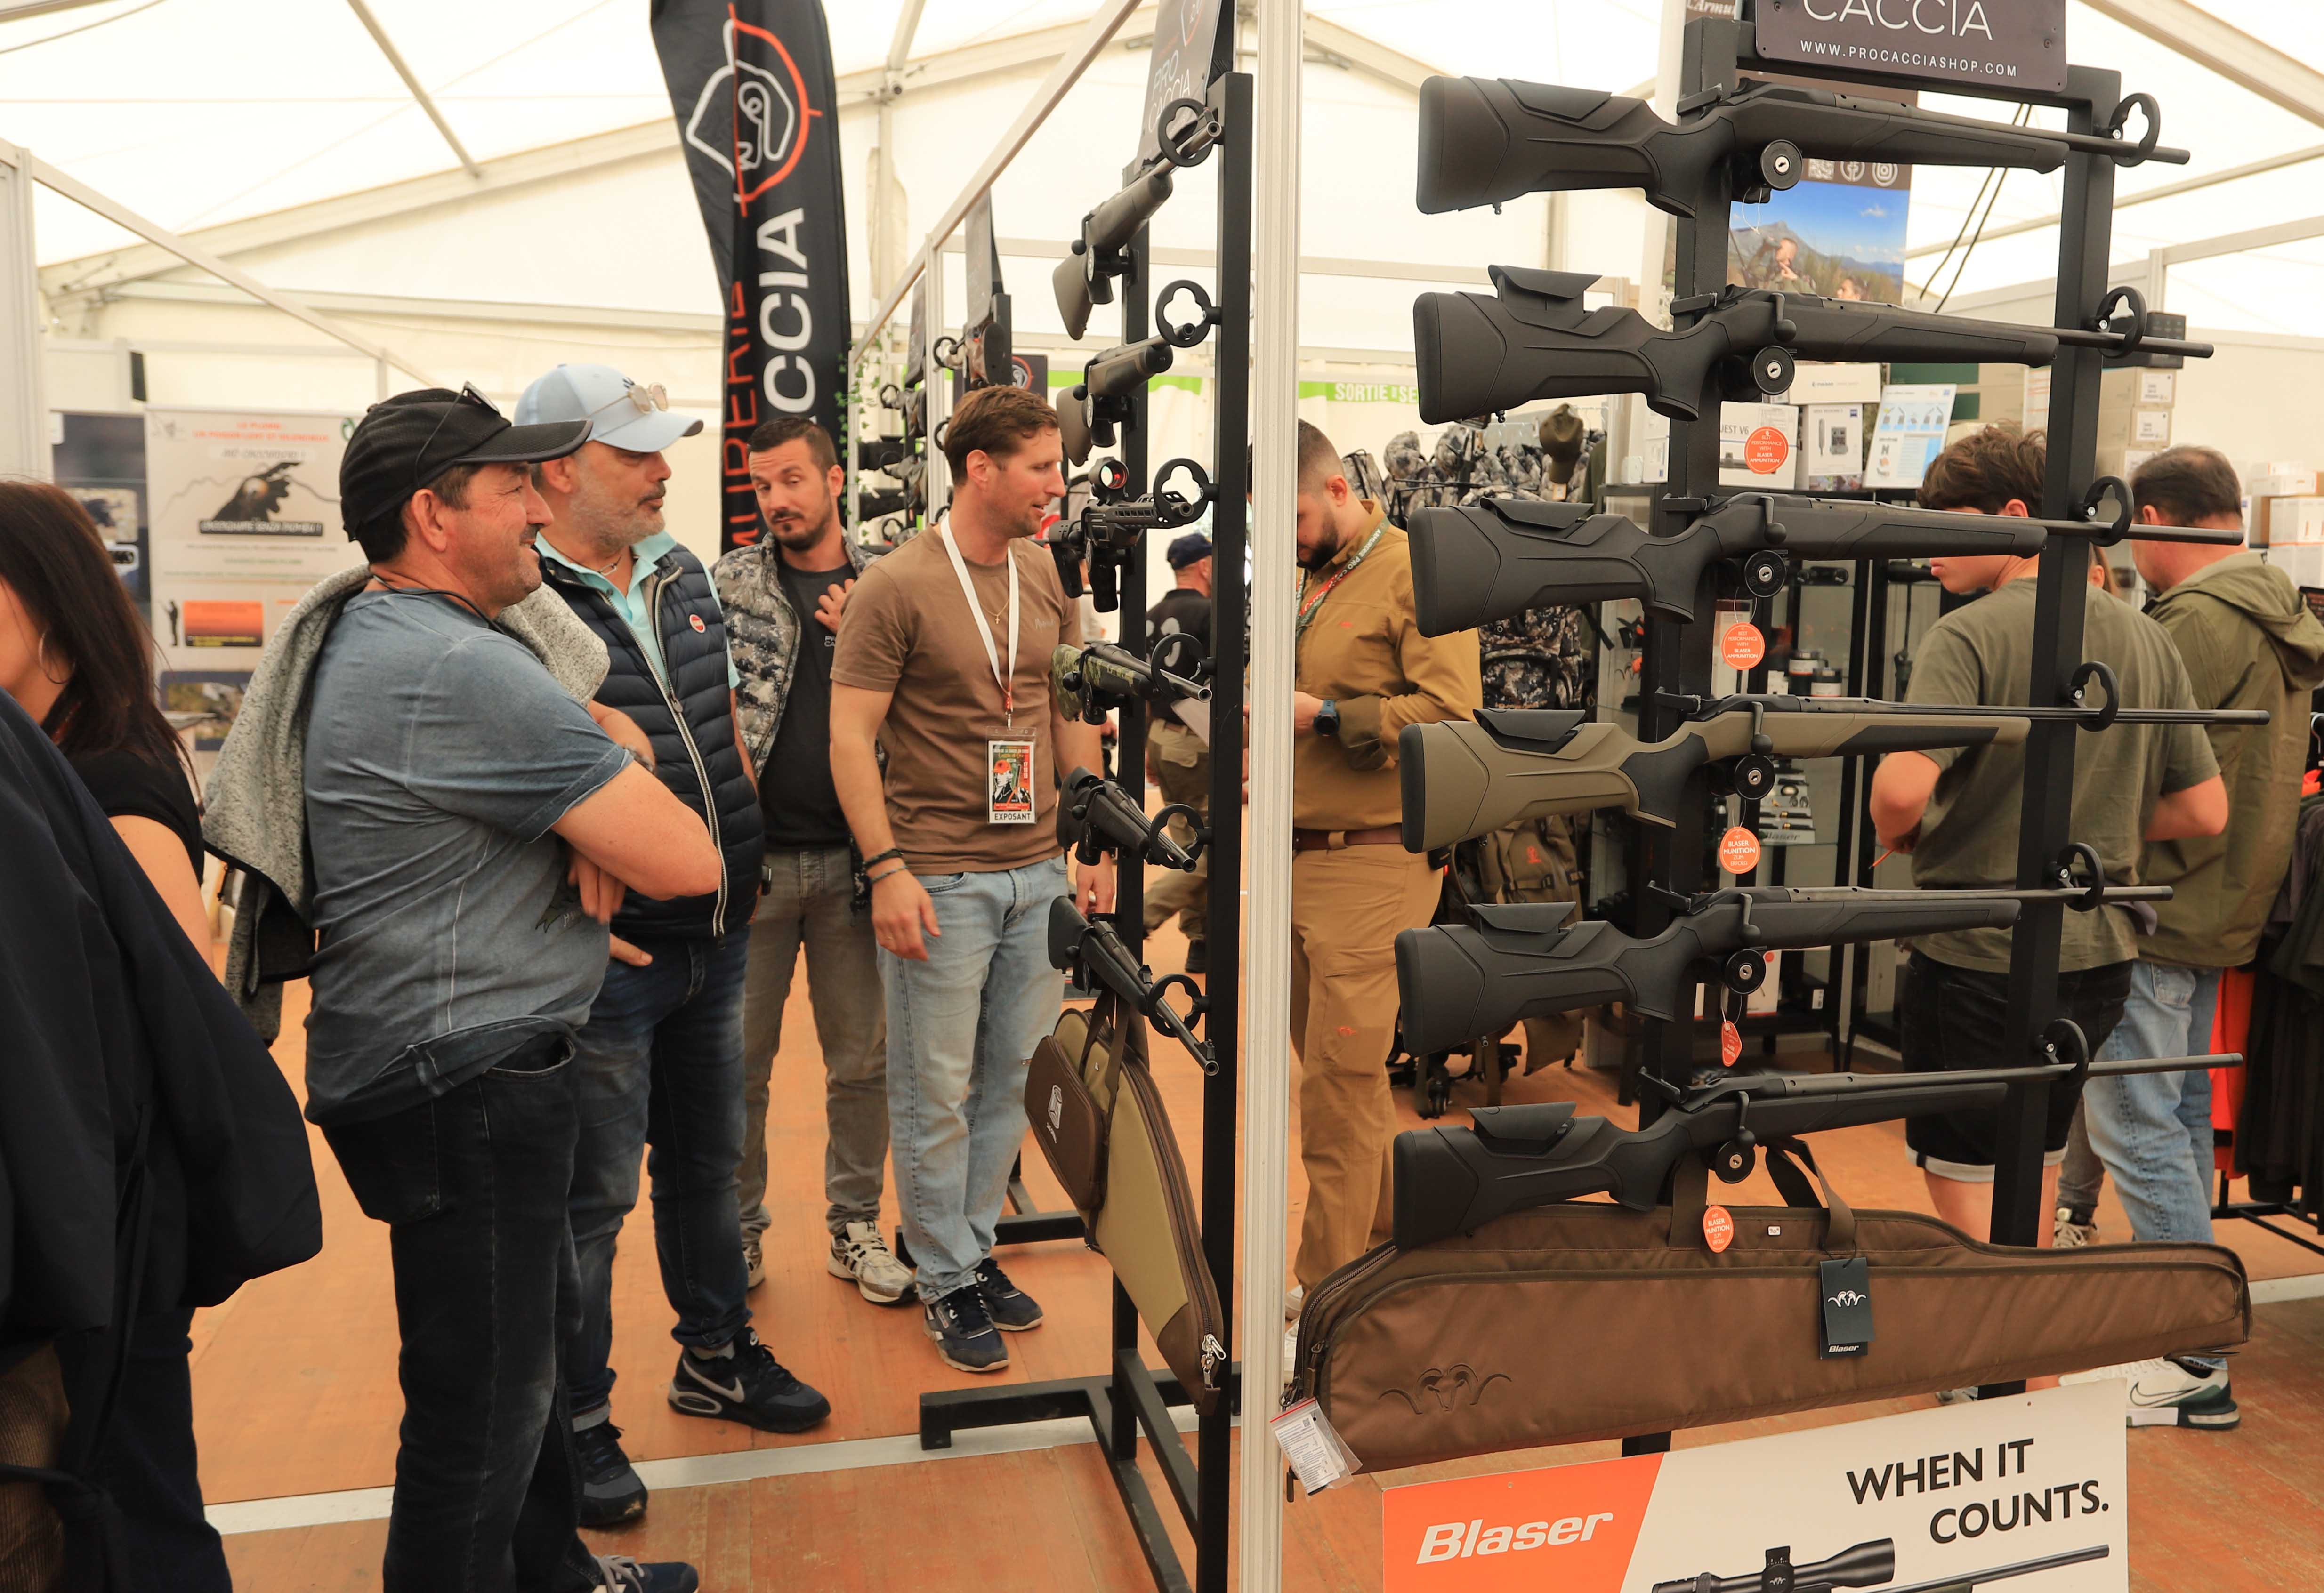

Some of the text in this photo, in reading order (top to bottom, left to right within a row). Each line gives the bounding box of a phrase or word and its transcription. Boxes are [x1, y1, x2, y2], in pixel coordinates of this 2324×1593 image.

[1153, 49, 1178, 90] PRO
[1800, 40, 2017, 77] WWW.PROCACCIASHOP.COM
[756, 208, 817, 421] CCIA
[1335, 383, 1388, 401] SORTIE
[1347, 556, 1361, 570] PRO
[1723, 847, 1755, 855] MUNITION
[1706, 1224, 1730, 1235] MUNITION
[1708, 1218, 1725, 1227] BLASER
[1846, 1438, 2034, 1505] WHEN IT
[1929, 1480, 2110, 1544] COUNTS.
[1416, 1512, 1614, 1565] Blaser
